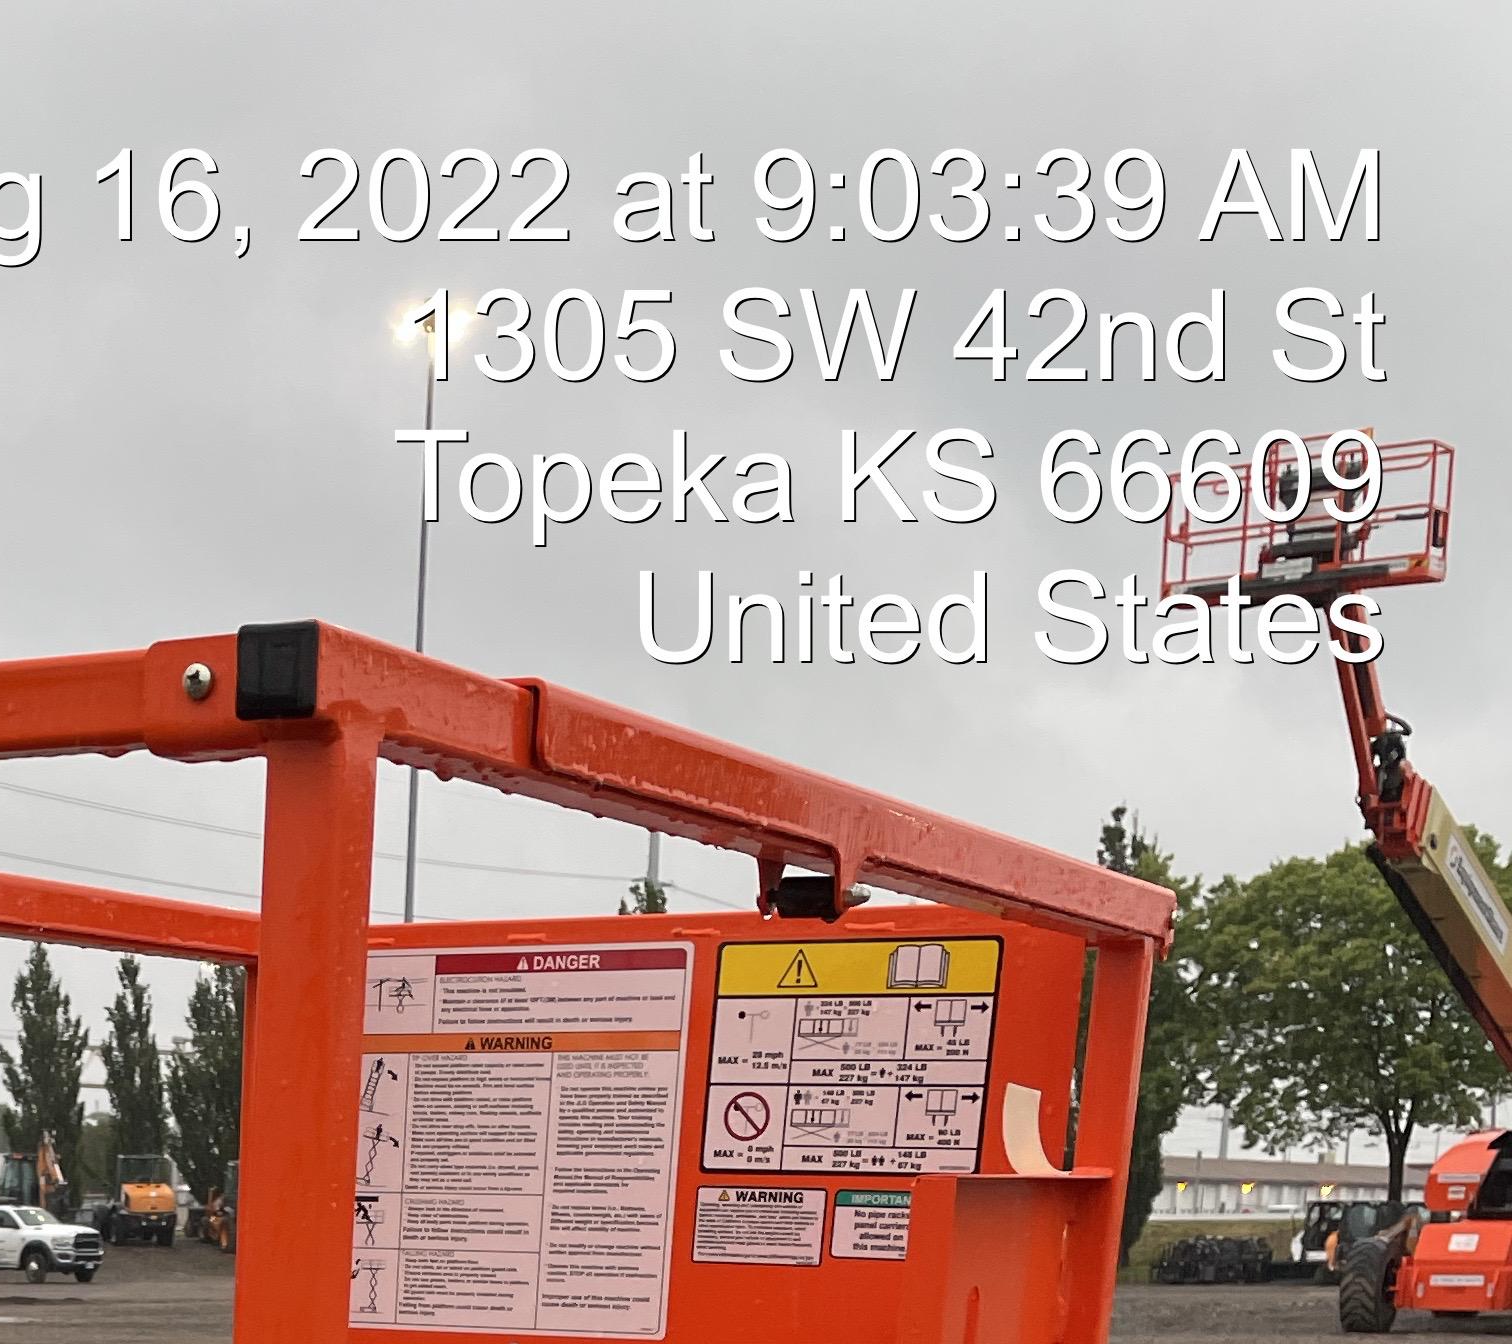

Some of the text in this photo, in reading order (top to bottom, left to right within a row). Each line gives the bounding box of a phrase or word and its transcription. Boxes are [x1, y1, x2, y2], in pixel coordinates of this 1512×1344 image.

[533, 954, 601, 970] DANGER
[480, 1036, 553, 1051] WARNING
[717, 1056, 739, 1065] MAX
[811, 1068, 834, 1077] MAX
[713, 1149, 735, 1158] MAX
[801, 1154, 824, 1164] MAX
[735, 1190, 804, 1204] WARNING
[851, 1194, 911, 1205] IMPORTAN
